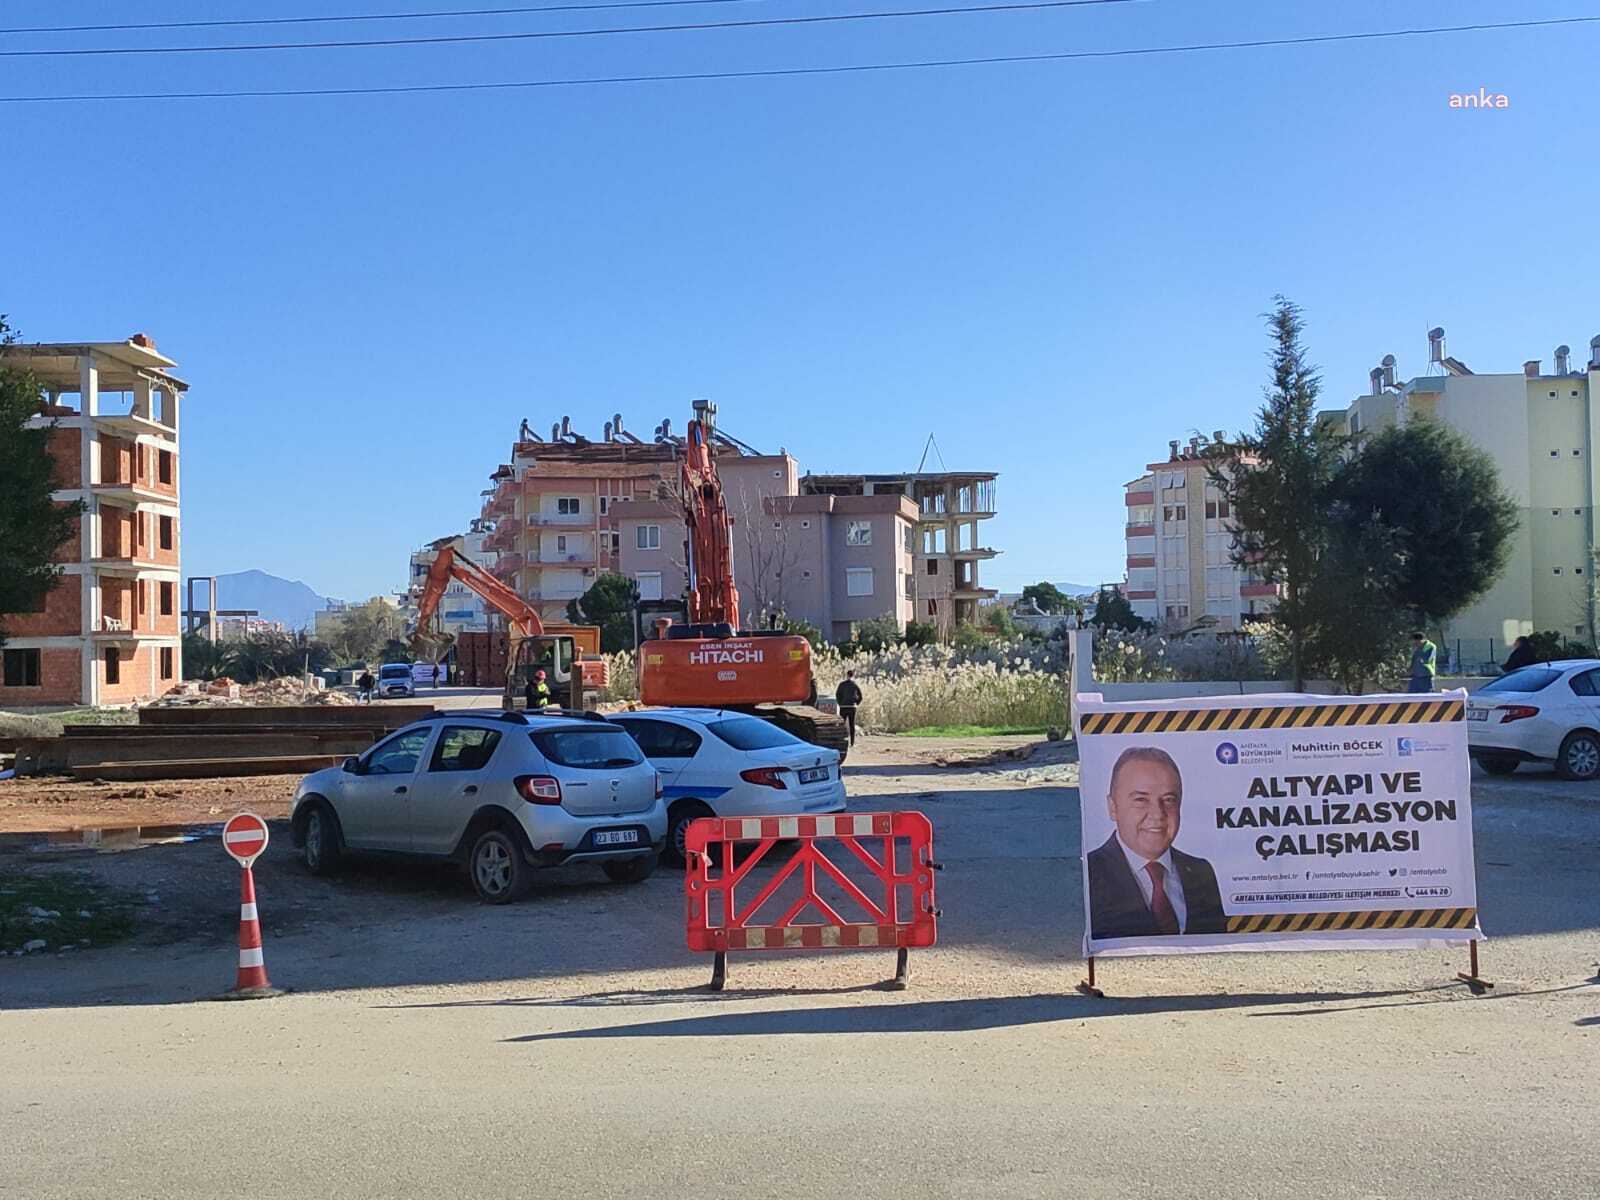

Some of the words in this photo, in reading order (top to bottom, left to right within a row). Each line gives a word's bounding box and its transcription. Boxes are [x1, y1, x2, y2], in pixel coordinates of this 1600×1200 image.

[690, 650, 764, 664] HITACHI
[1292, 741, 1340, 752] Muhittin
[1343, 739, 1384, 751] BÖCEK
[1247, 773, 1373, 799] ALTYAPI
[1380, 771, 1422, 794] VE
[1215, 799, 1457, 829] KANALİZASYON
[1255, 830, 1420, 861] ÇALIŞMASI
